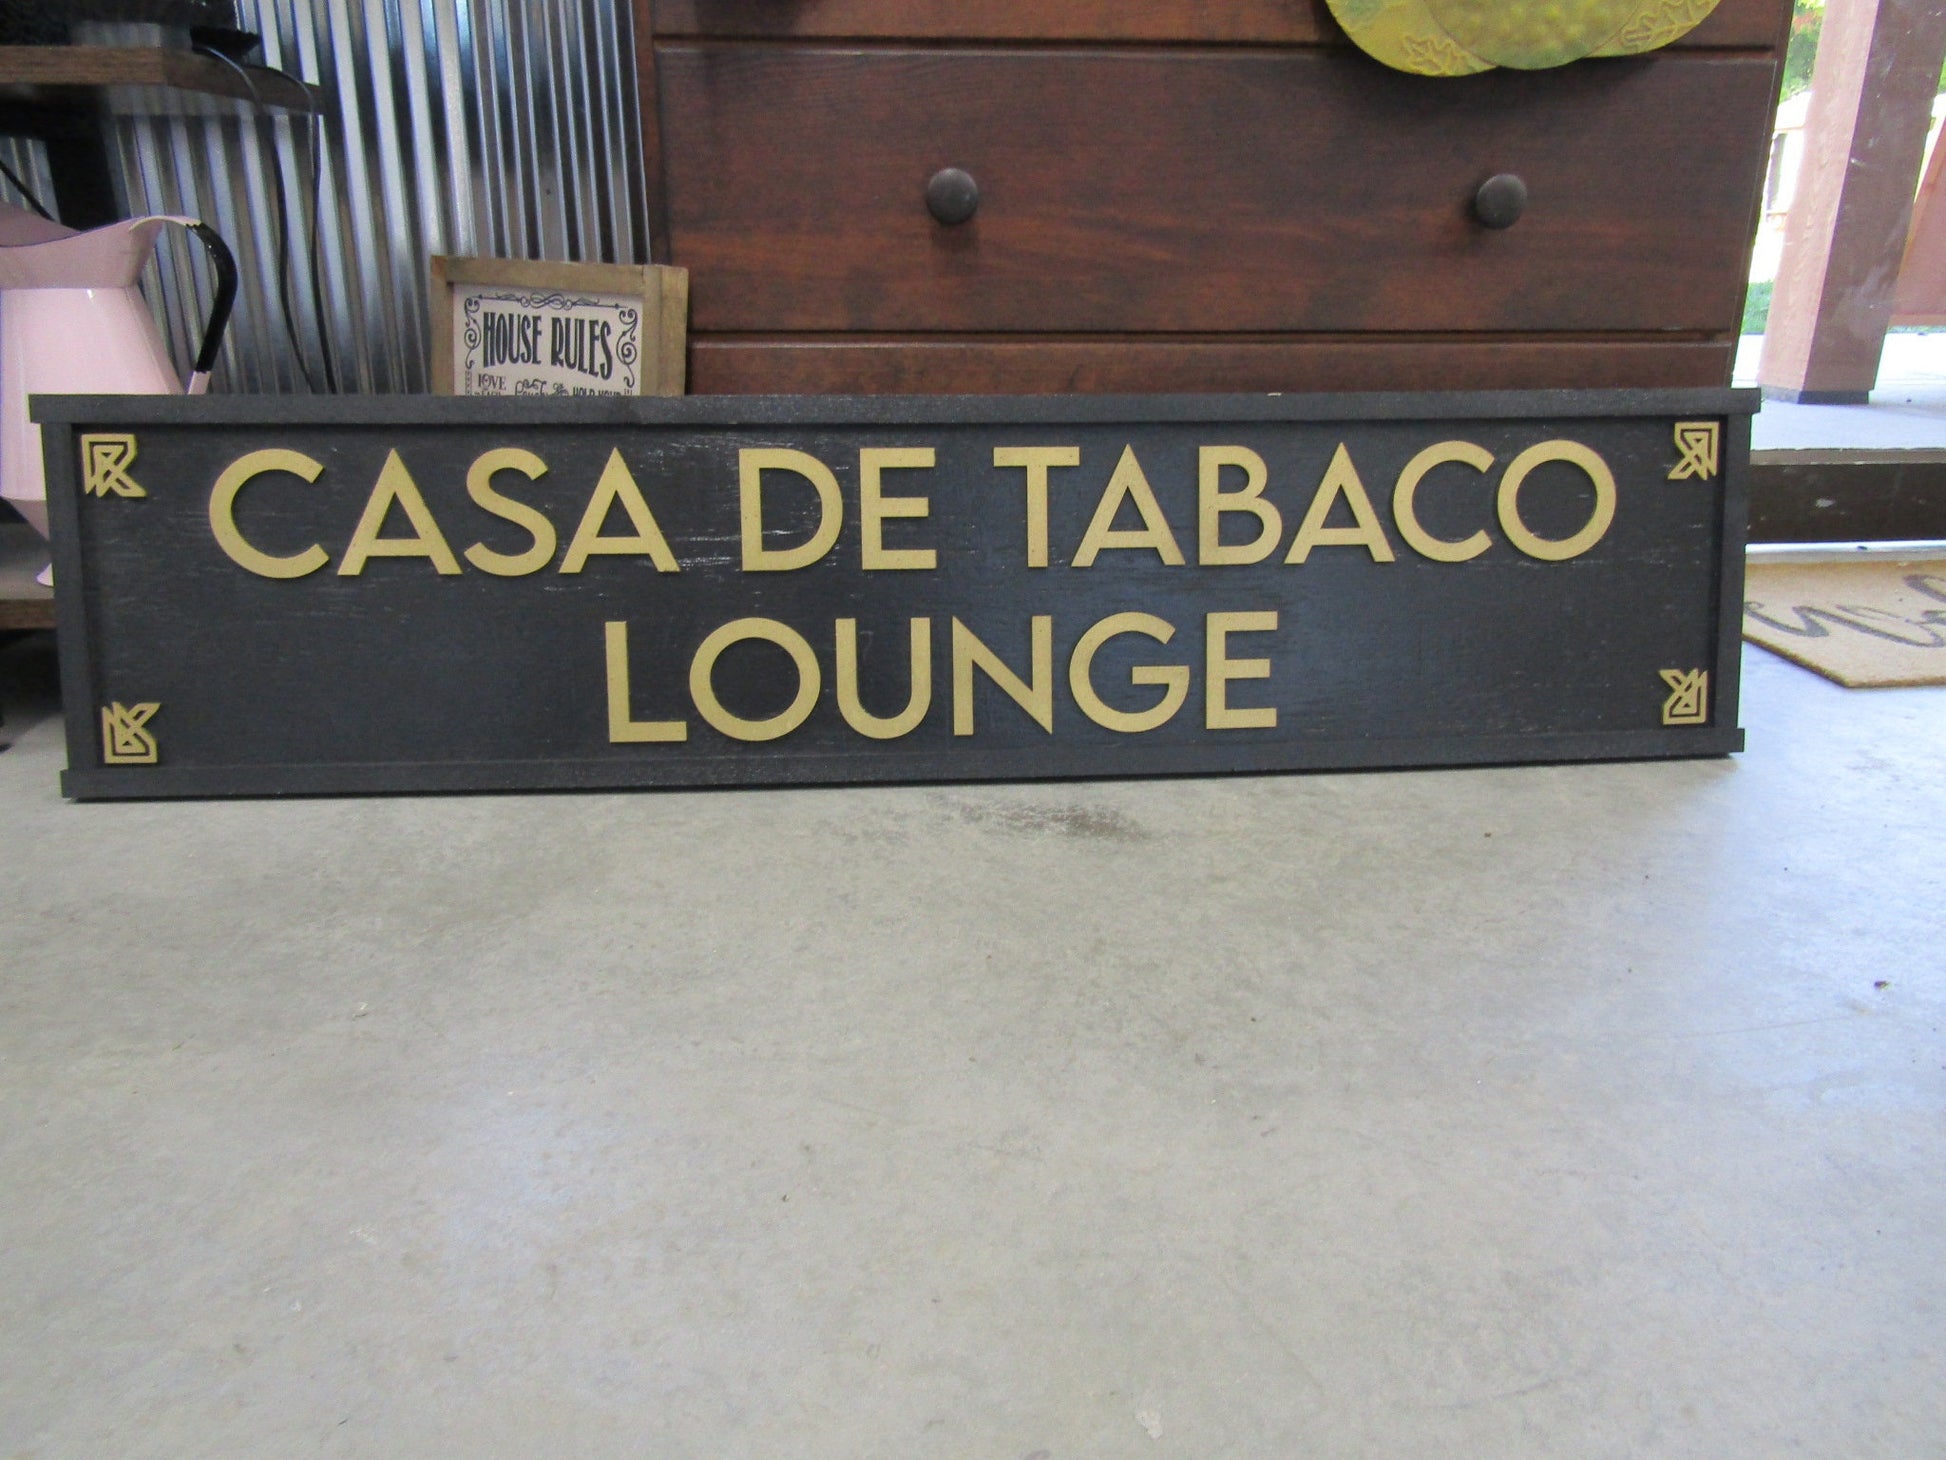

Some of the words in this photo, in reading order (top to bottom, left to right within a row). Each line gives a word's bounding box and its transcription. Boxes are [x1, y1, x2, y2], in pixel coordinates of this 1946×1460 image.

[477, 373, 507, 390] LOVE
[483, 311, 542, 368] HOUSE
[550, 316, 613, 380] RULES
[208, 447, 680, 579] CASA
[738, 447, 937, 571] DE
[993, 439, 1618, 569] TABACO
[604, 611, 1280, 743] LOUNGE
